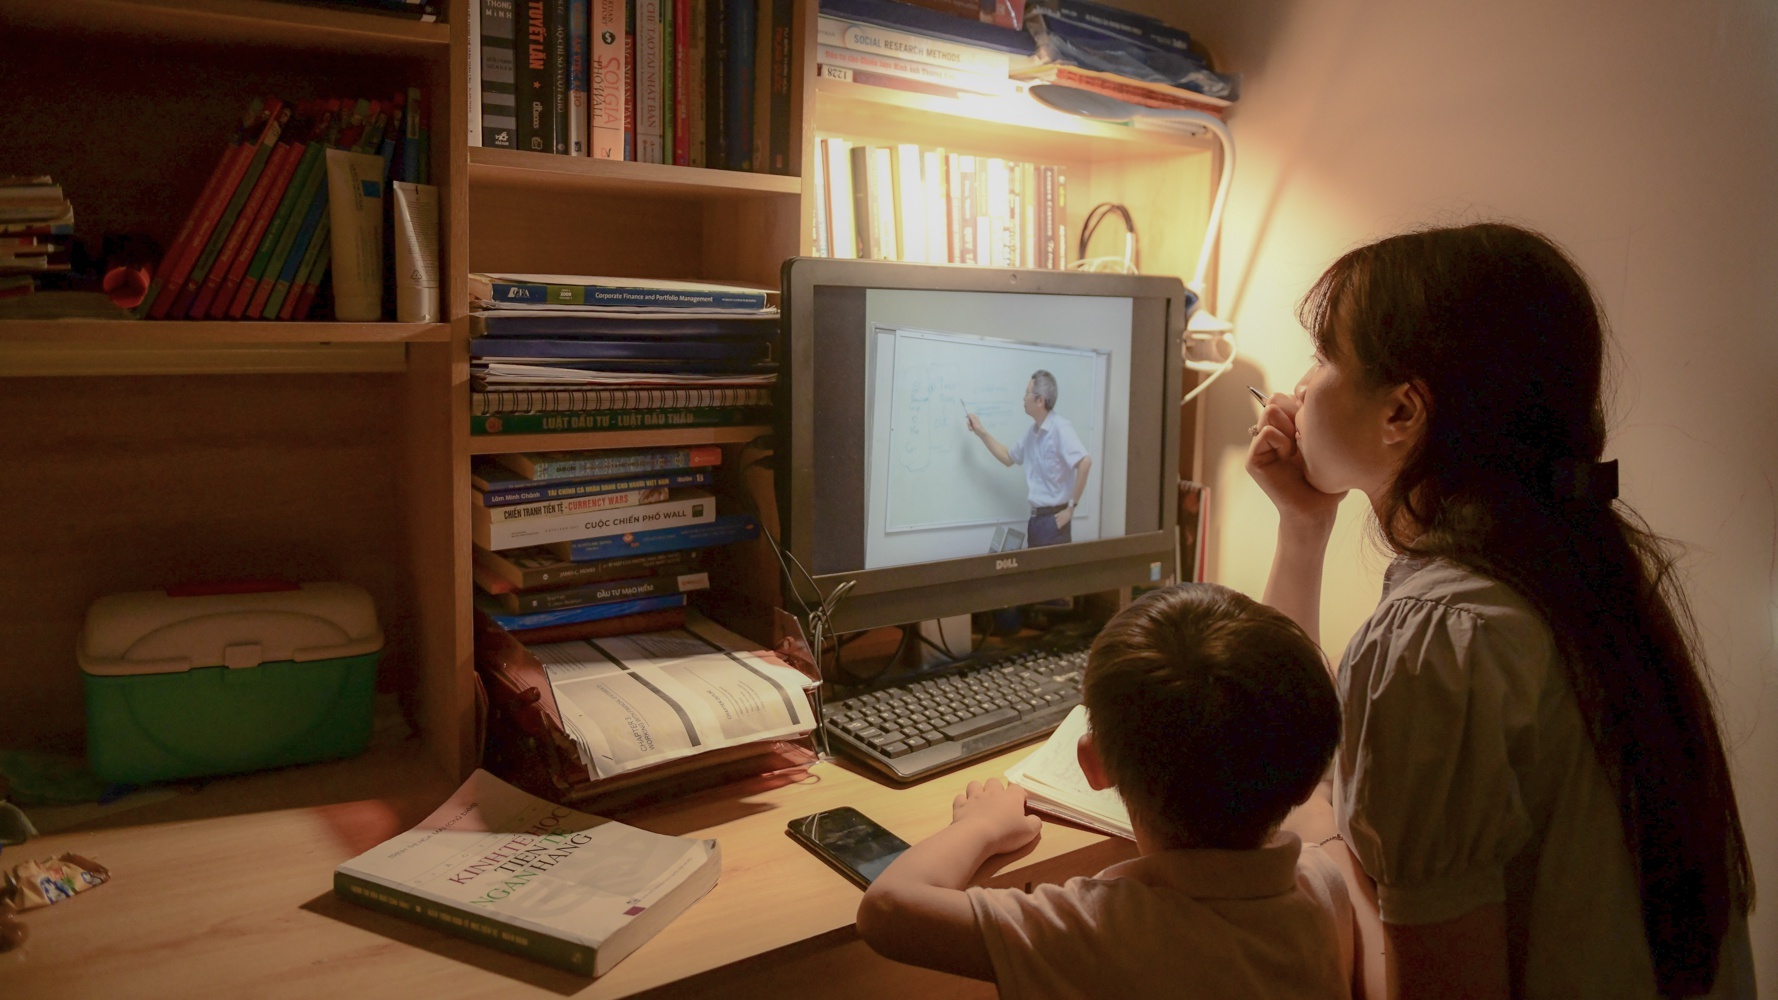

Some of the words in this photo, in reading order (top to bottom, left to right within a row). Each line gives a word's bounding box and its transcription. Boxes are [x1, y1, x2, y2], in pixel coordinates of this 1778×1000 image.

[854, 34, 881, 48] SOCIAL
[884, 40, 924, 54] RESEARCH
[926, 48, 961, 62] METHODS
[827, 68, 847, 80] 1228
[595, 292, 622, 300] Corporate
[679, 295, 714, 304] Management
[523, 505, 542, 516] TRANH
[568, 497, 607, 511] CURRENCY
[608, 494, 629, 505] WARS
[584, 518, 610, 530] CUỘC
[613, 512, 640, 526] CHIẾN
[663, 509, 687, 519] WALL
[996, 558, 1018, 570] DELL
[628, 720, 647, 752] CHAPTER
[448, 851, 509, 885] KINH
[499, 834, 534, 852] TẾ
[524, 806, 572, 837] HỌC
[469, 869, 540, 907] NGÂN
[530, 833, 592, 872] HÀNG
